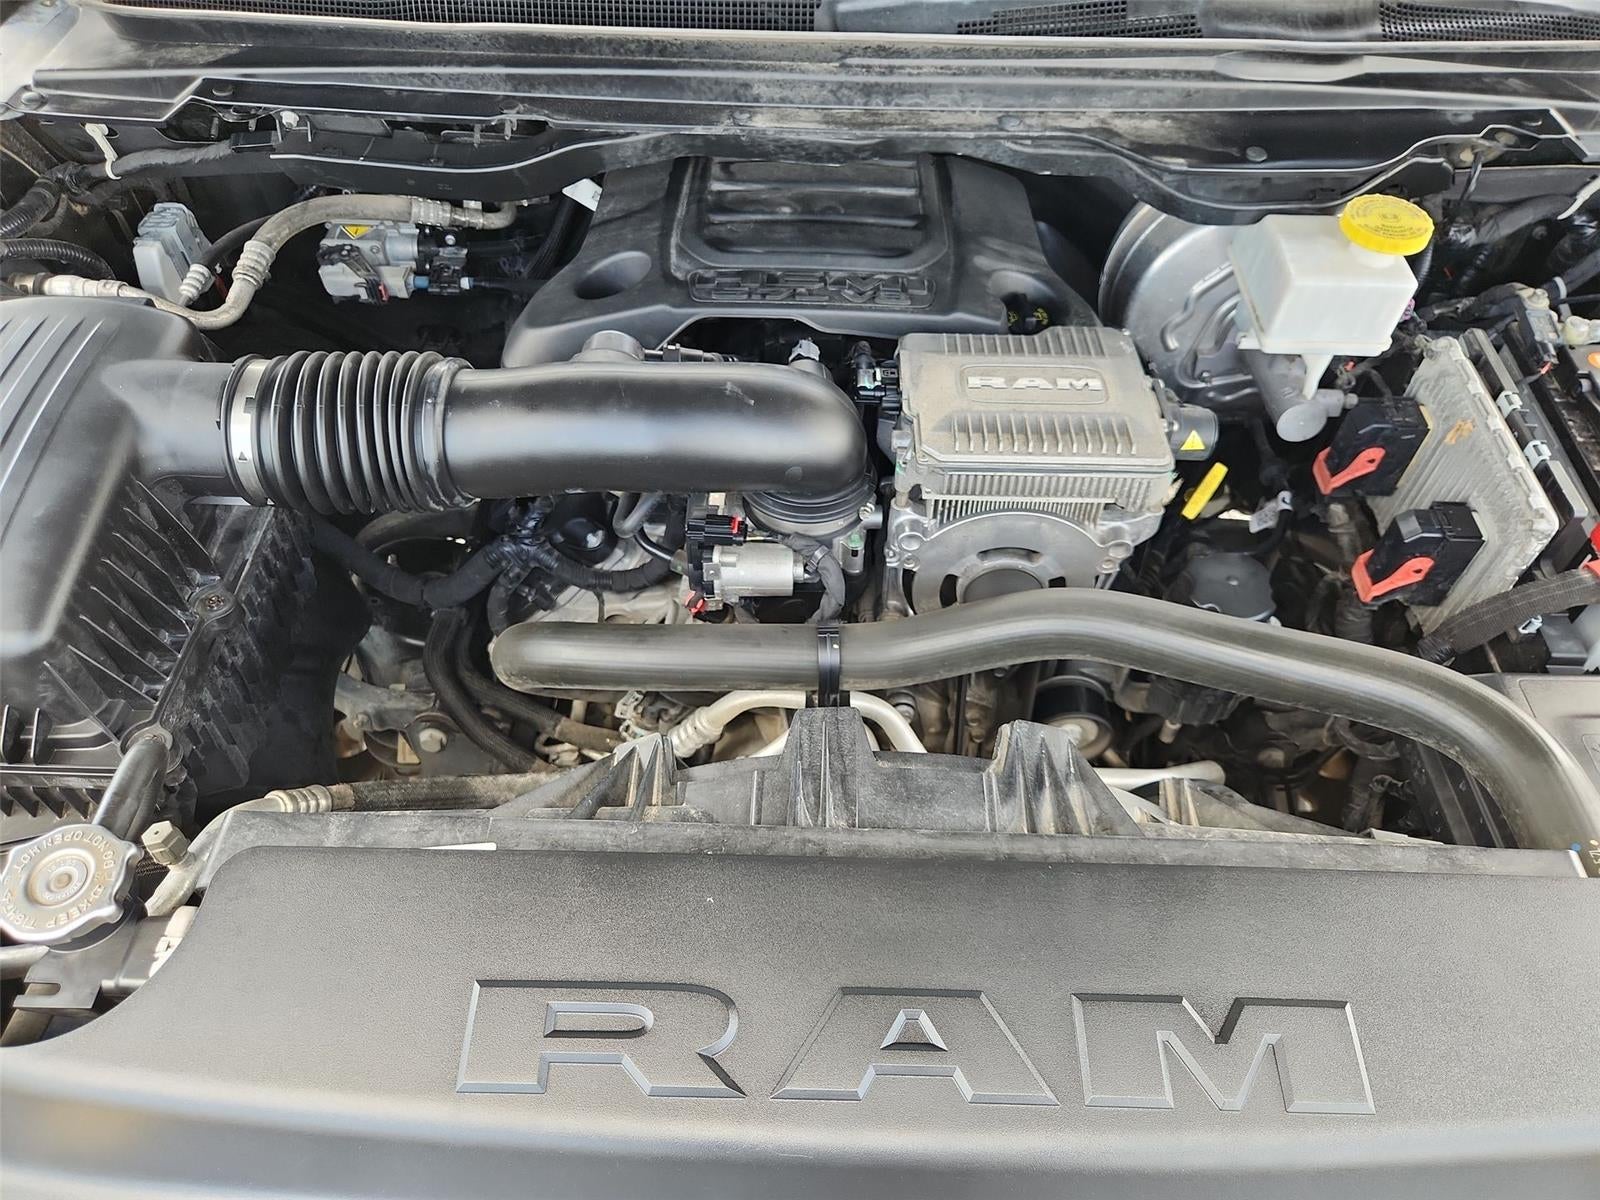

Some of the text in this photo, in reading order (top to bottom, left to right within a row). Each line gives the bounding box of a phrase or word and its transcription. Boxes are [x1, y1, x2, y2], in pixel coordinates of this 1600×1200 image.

[967, 376, 1104, 391] RAM
[42, 830, 83, 849] OPEN
[456, 979, 1376, 1115] RAM
